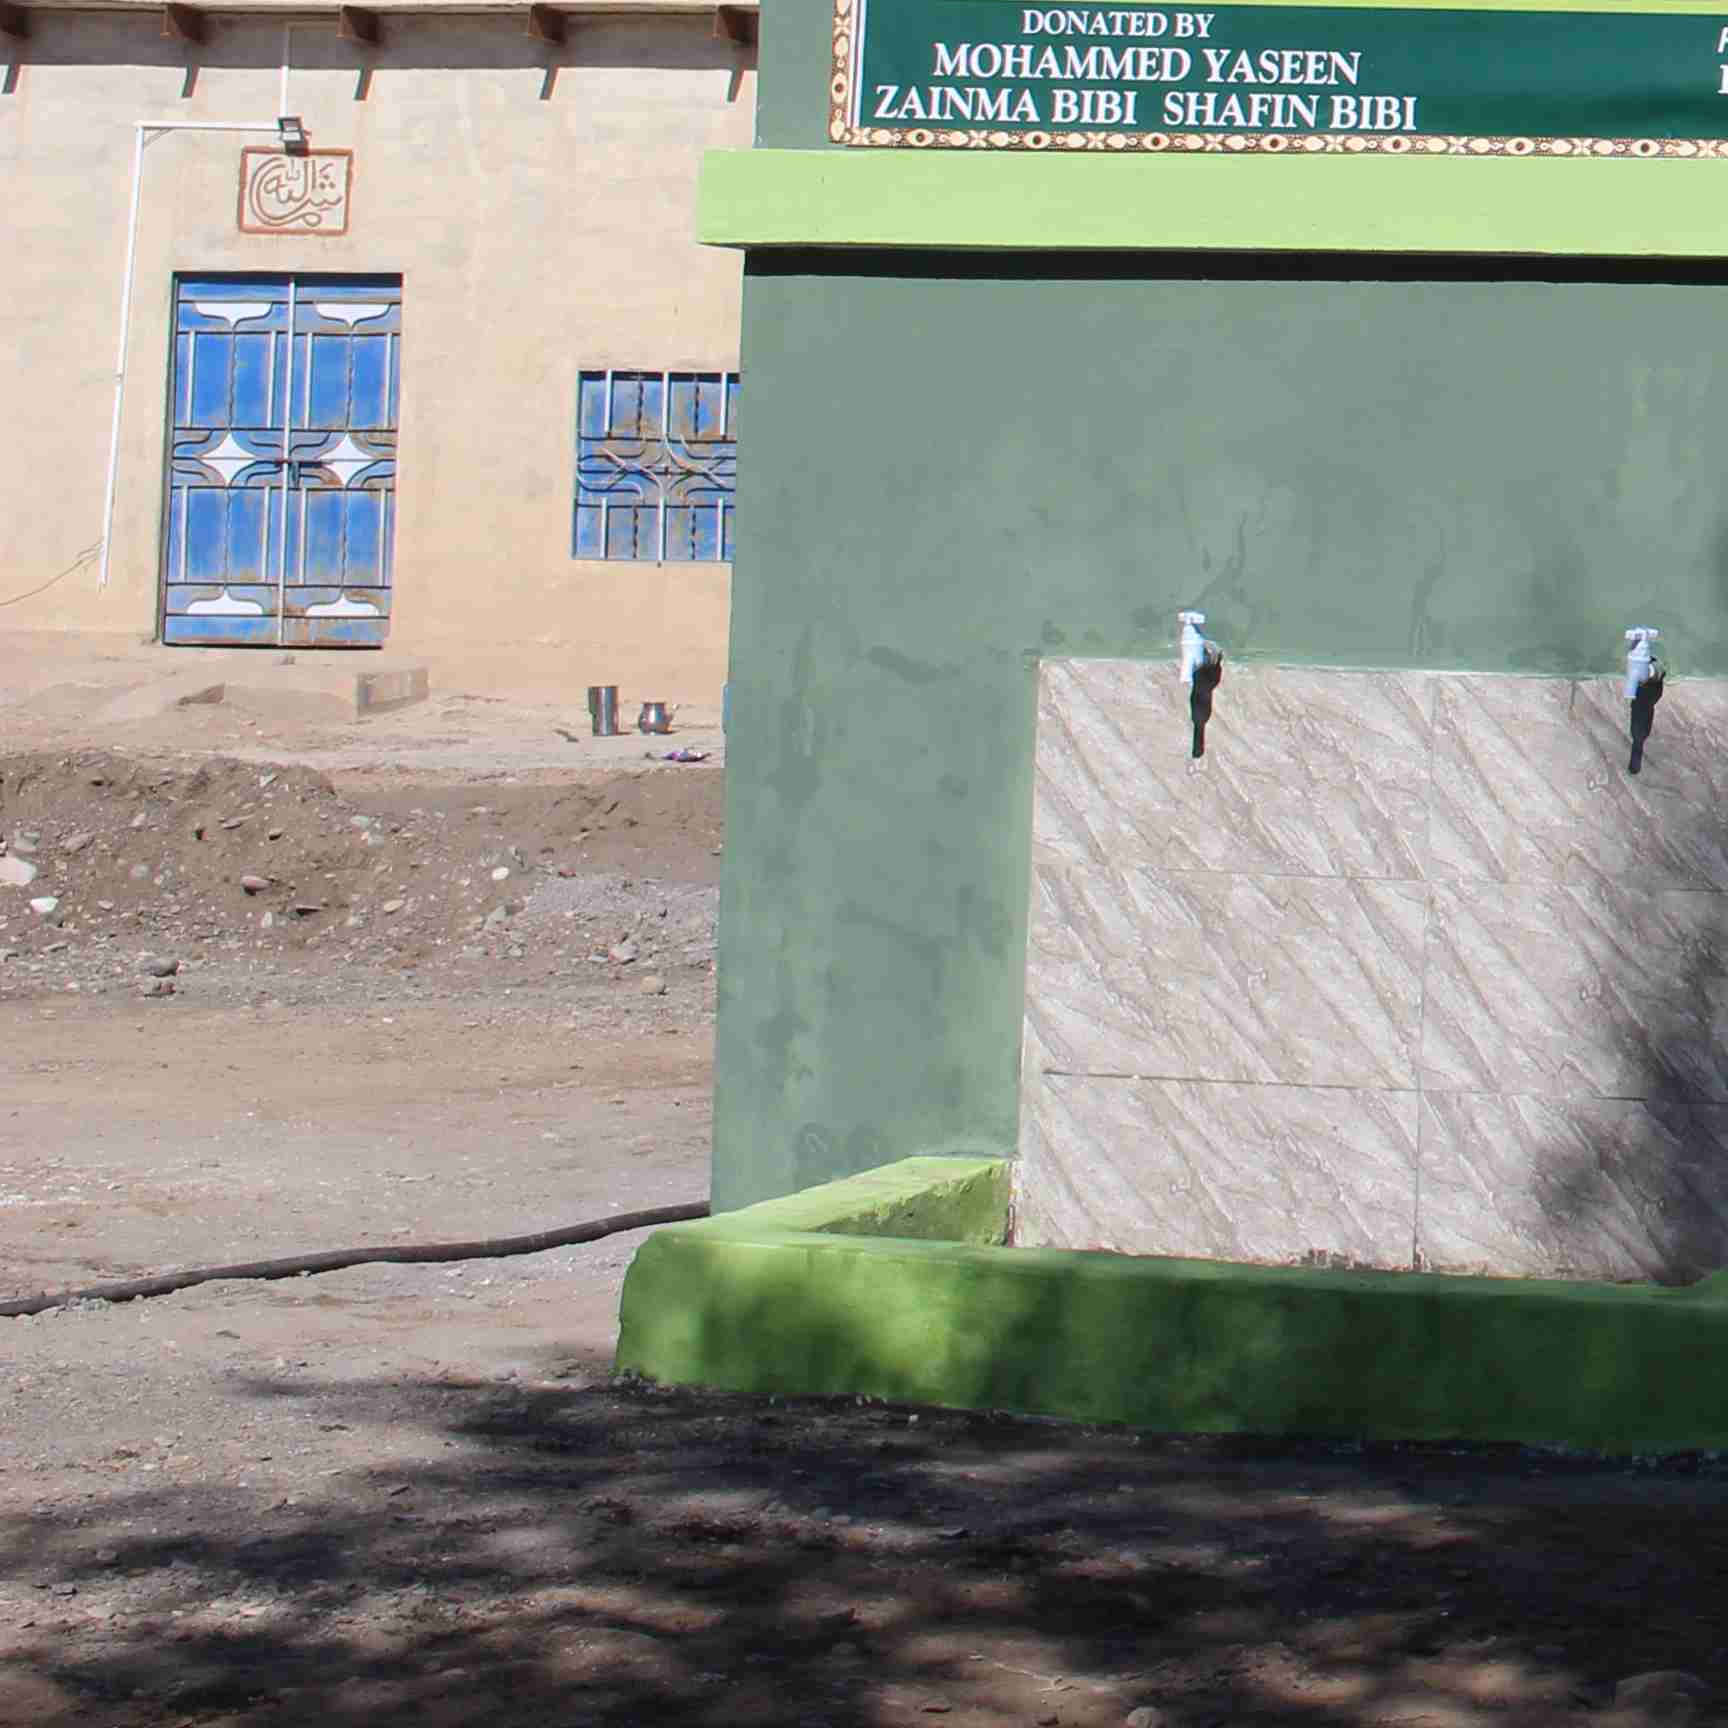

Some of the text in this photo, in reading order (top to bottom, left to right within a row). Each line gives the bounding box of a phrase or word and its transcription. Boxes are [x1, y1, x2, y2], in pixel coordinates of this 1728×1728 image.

[1022, 9, 1214, 38] DONATED BY
[932, 42, 1361, 85] MOHAMMED YASEEN
[874, 85, 1417, 131] ZAINMA BIBI SHAFIN BIBI
